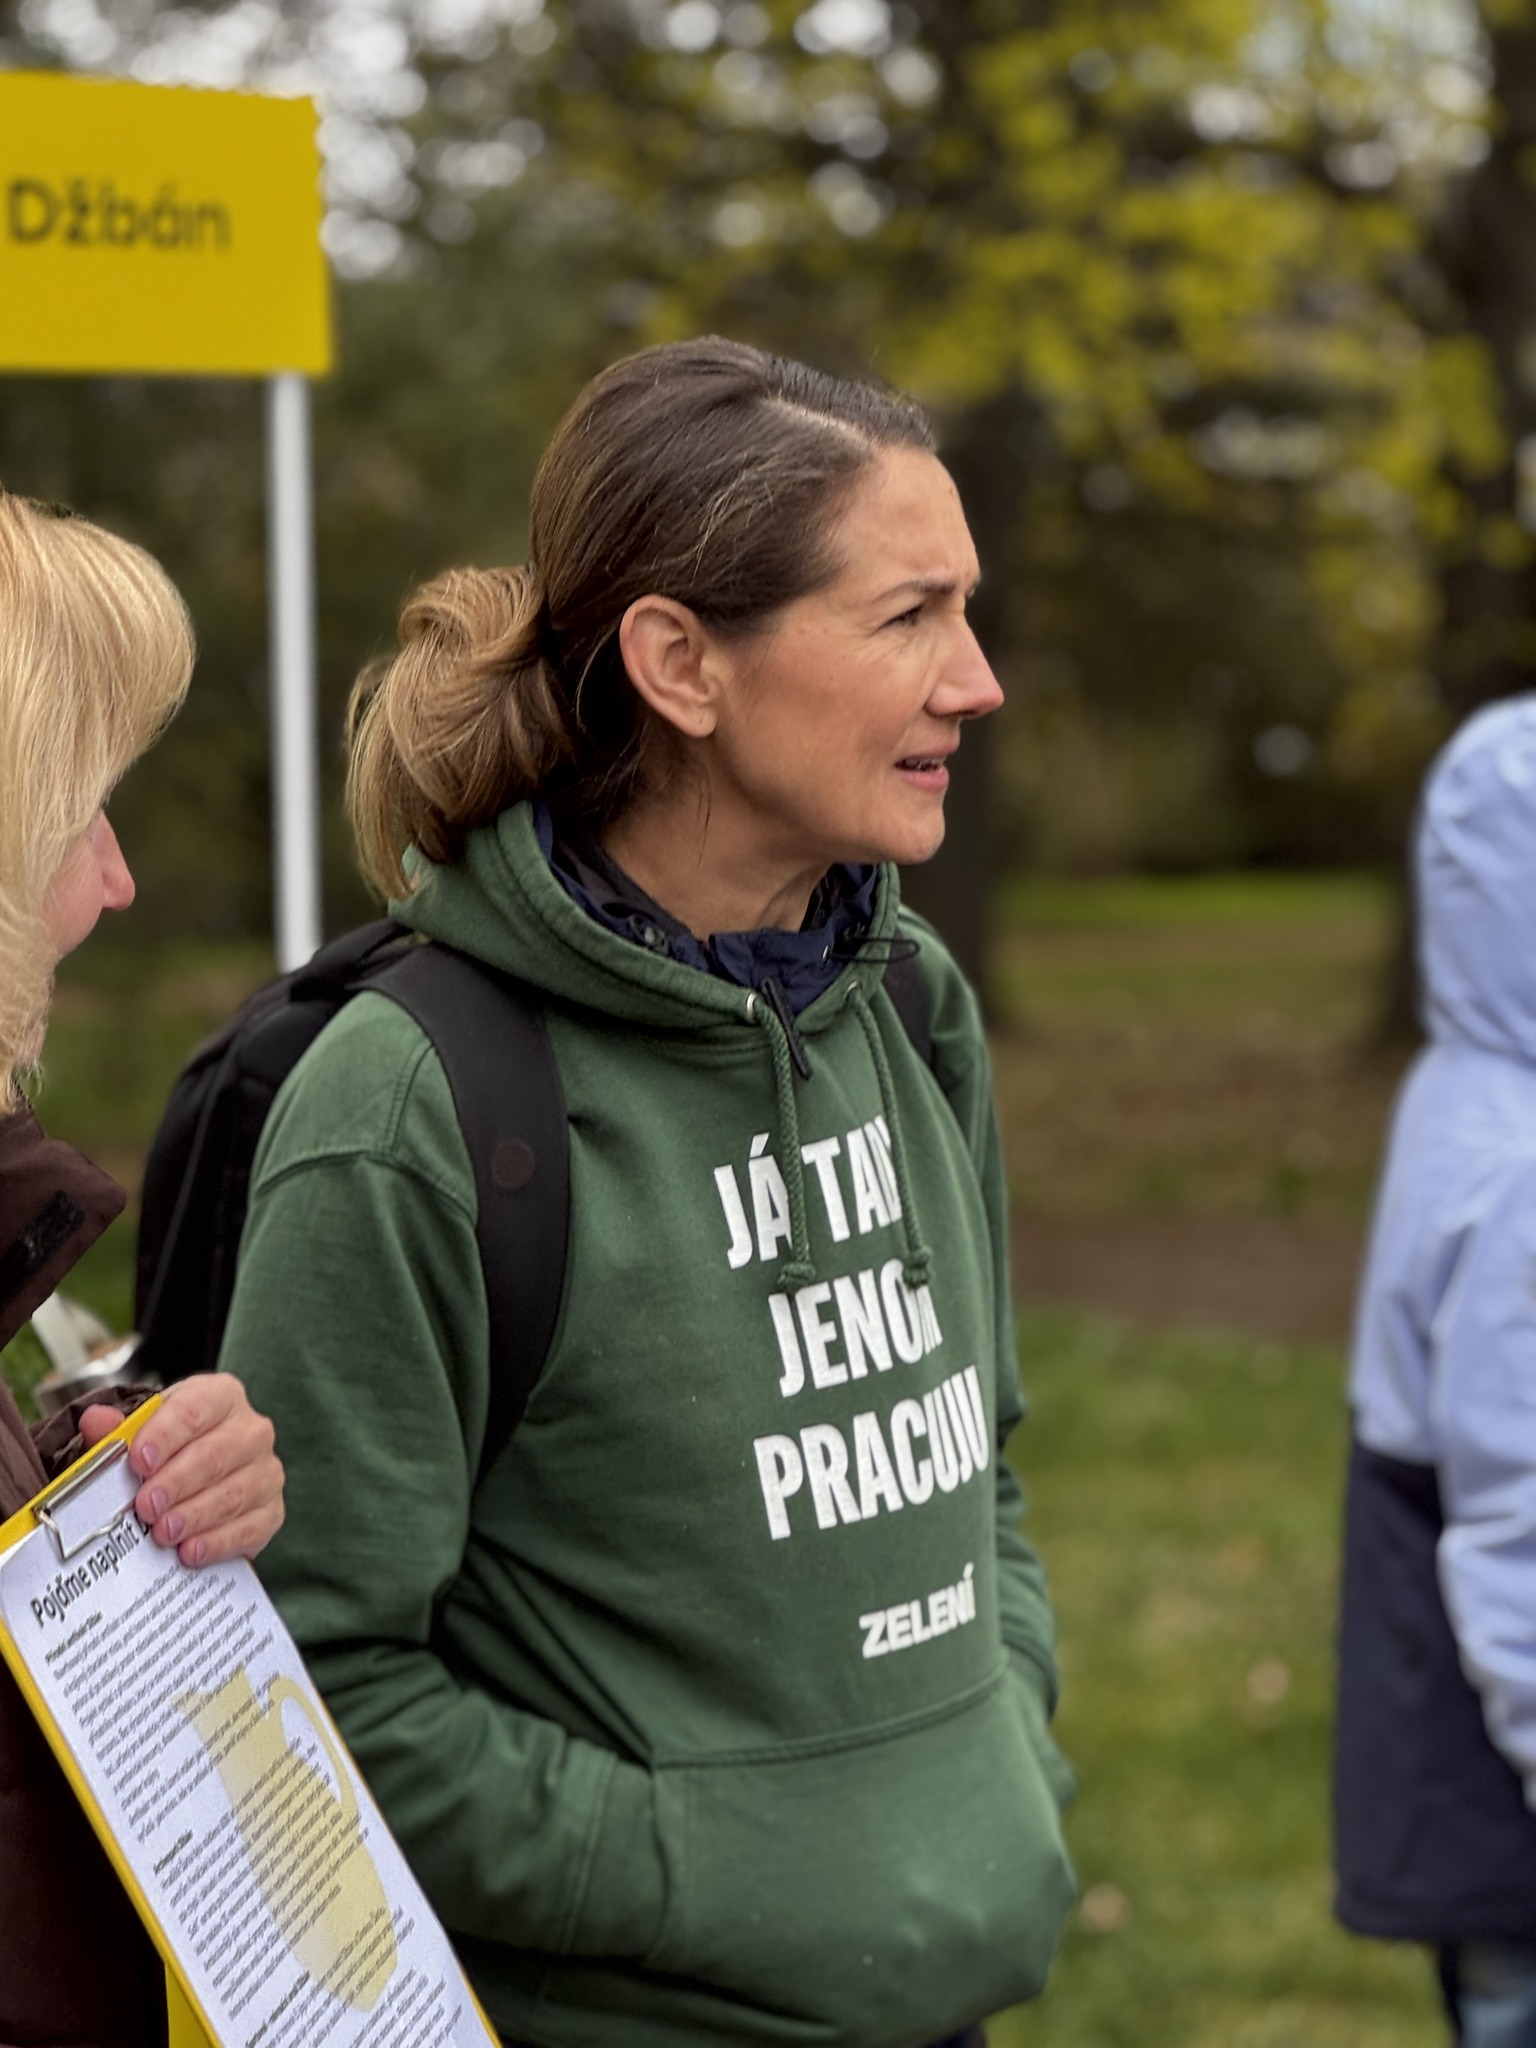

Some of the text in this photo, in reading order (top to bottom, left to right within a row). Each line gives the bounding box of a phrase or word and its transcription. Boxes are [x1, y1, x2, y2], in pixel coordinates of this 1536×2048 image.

[7, 176, 233, 252] Džbán
[713, 1133, 792, 1270] JÁ
[753, 1365, 990, 1541] PRACUJU
[29, 1572, 92, 1629] Pojďme
[858, 1562, 977, 1659] ZELENÍ
